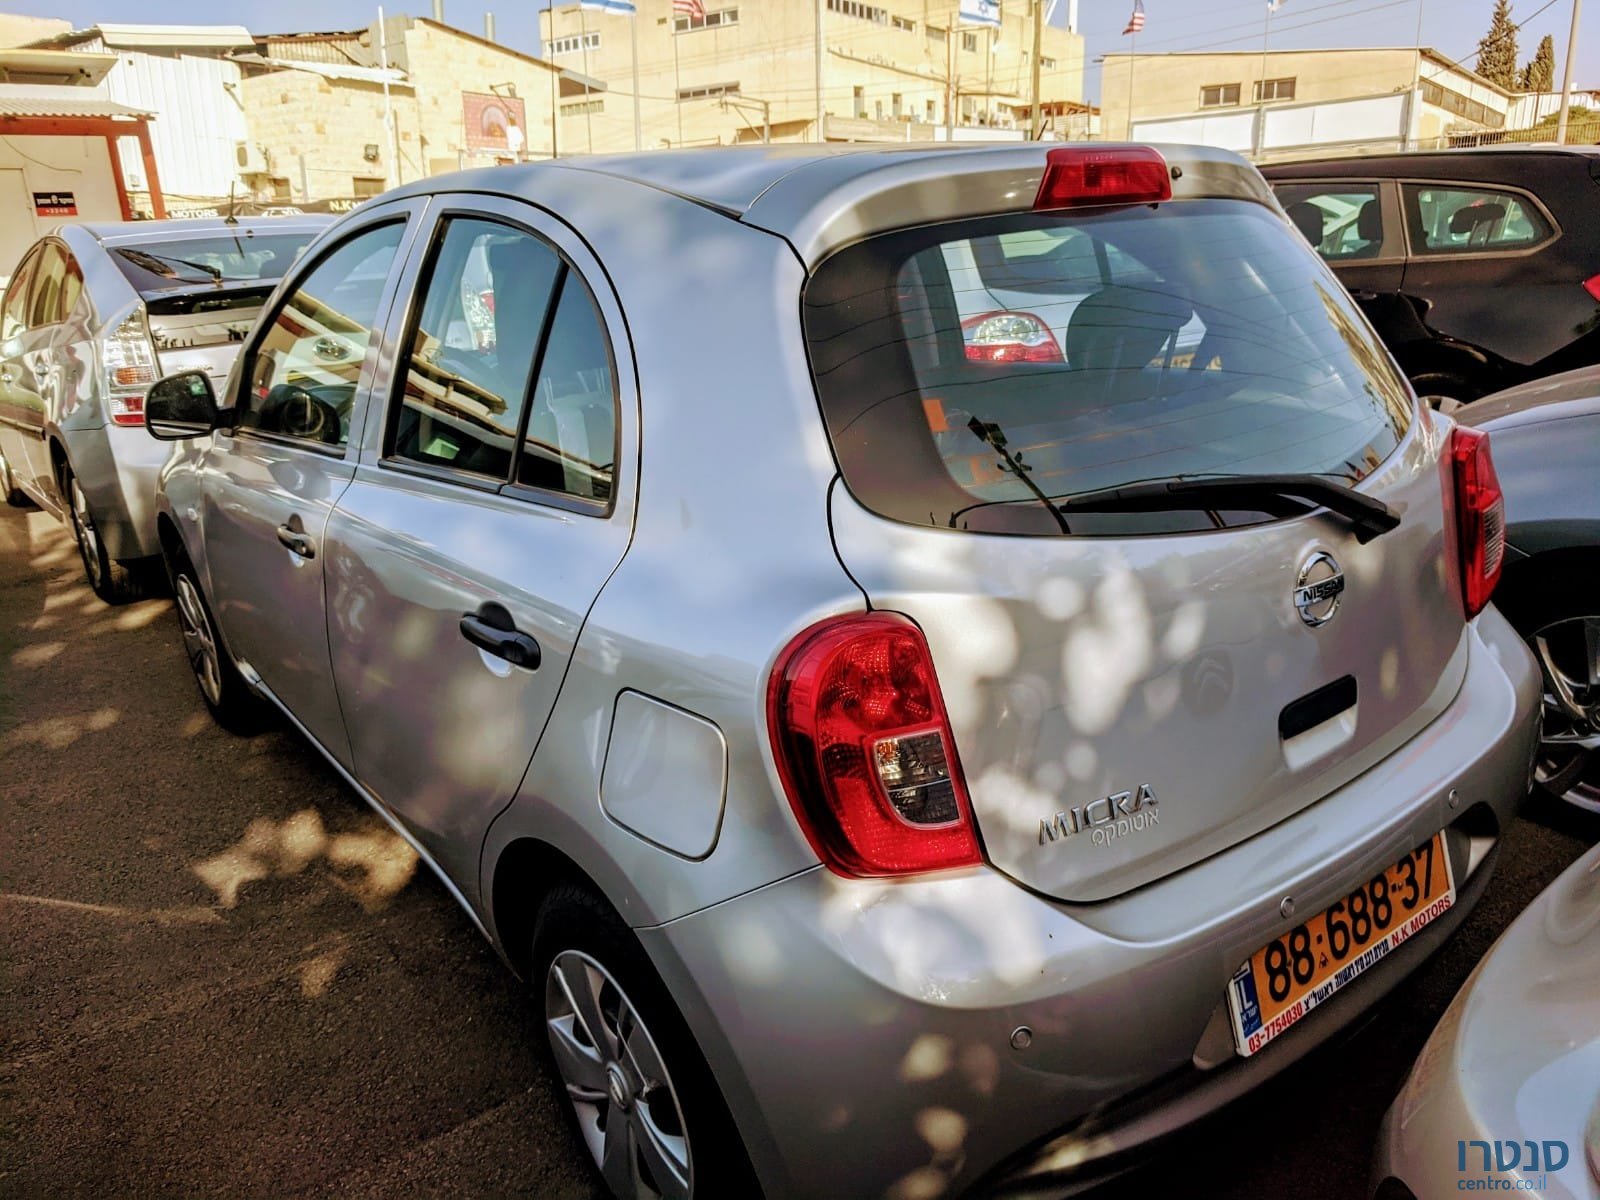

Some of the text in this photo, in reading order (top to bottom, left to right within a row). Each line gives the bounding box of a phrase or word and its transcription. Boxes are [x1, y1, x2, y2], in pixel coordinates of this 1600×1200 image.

[170, 208, 218, 219] MOTORS
[329, 200, 353, 212] N.K
[1038, 782, 1159, 846] MICRA
[1264, 838, 1434, 1003] 88-688-37
[1391, 894, 1451, 947] N.K MOTORS
[1235, 979, 1253, 1013] IL
[1248, 1001, 1303, 1053] 03-7754030
